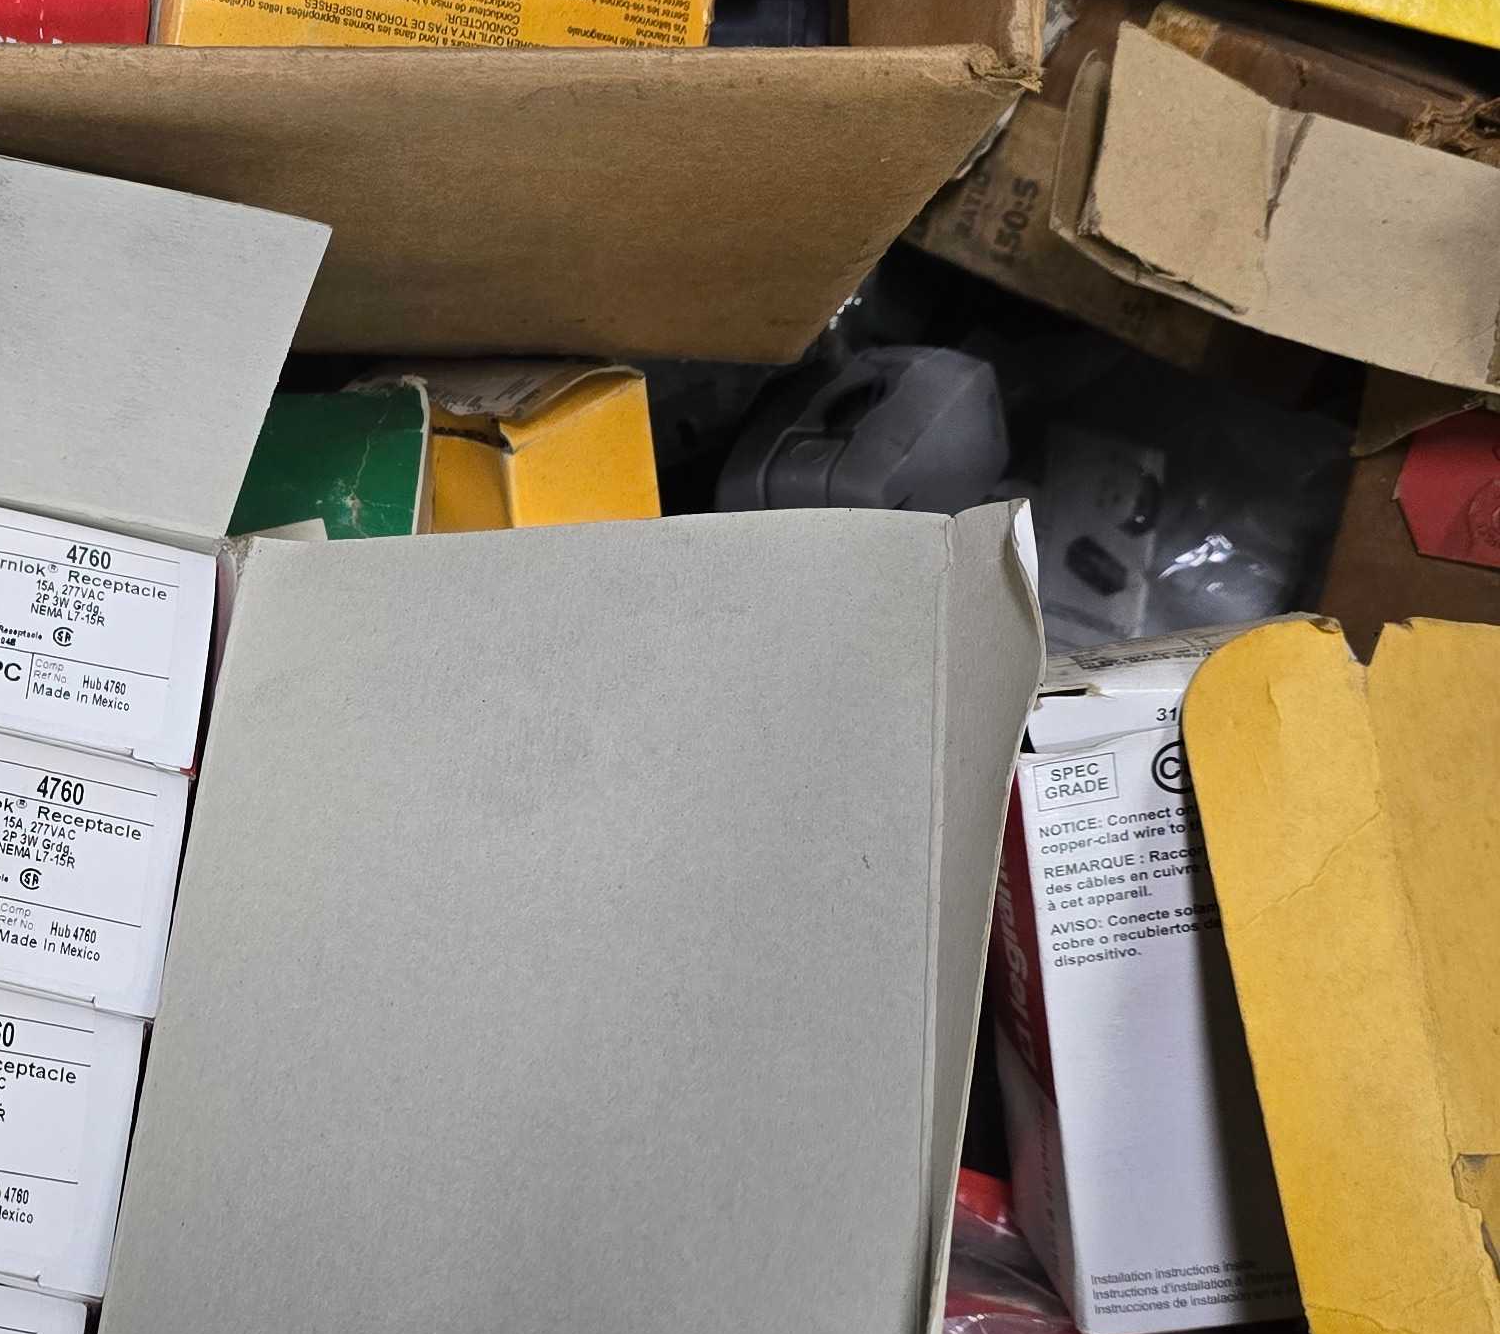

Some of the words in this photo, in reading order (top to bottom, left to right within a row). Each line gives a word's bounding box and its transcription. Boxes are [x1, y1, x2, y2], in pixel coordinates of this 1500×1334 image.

[365, 8, 409, 28] TORONS
[66, 544, 111, 570] 4760
[65, 569, 167, 600] Receptacle
[1051, 763, 1099, 782] SPEC
[36, 775, 84, 806] 4760
[1045, 778, 1110, 799] GRADE
[34, 805, 141, 840] Receptacle
[1039, 818, 1103, 838] NOTICE:
[1107, 808, 1170, 827] Connect
[1041, 832, 1129, 855] copper-clad
[1134, 826, 1166, 839] wire
[1170, 821, 1186, 834] to
[1044, 854, 1135, 879] REMARQUE
[1046, 882, 1072, 895] des
[1131, 871, 1149, 882] en
[1060, 897, 1084, 909] cet
[1051, 919, 1103, 936] AVISO:
[1107, 908, 1170, 927] Conecte
[1053, 936, 1095, 952] cobre
[1100, 935, 1108, 945] o
[1113, 921, 1198, 942] recubiertos
[1054, 947, 1142, 967] dispositivo.
